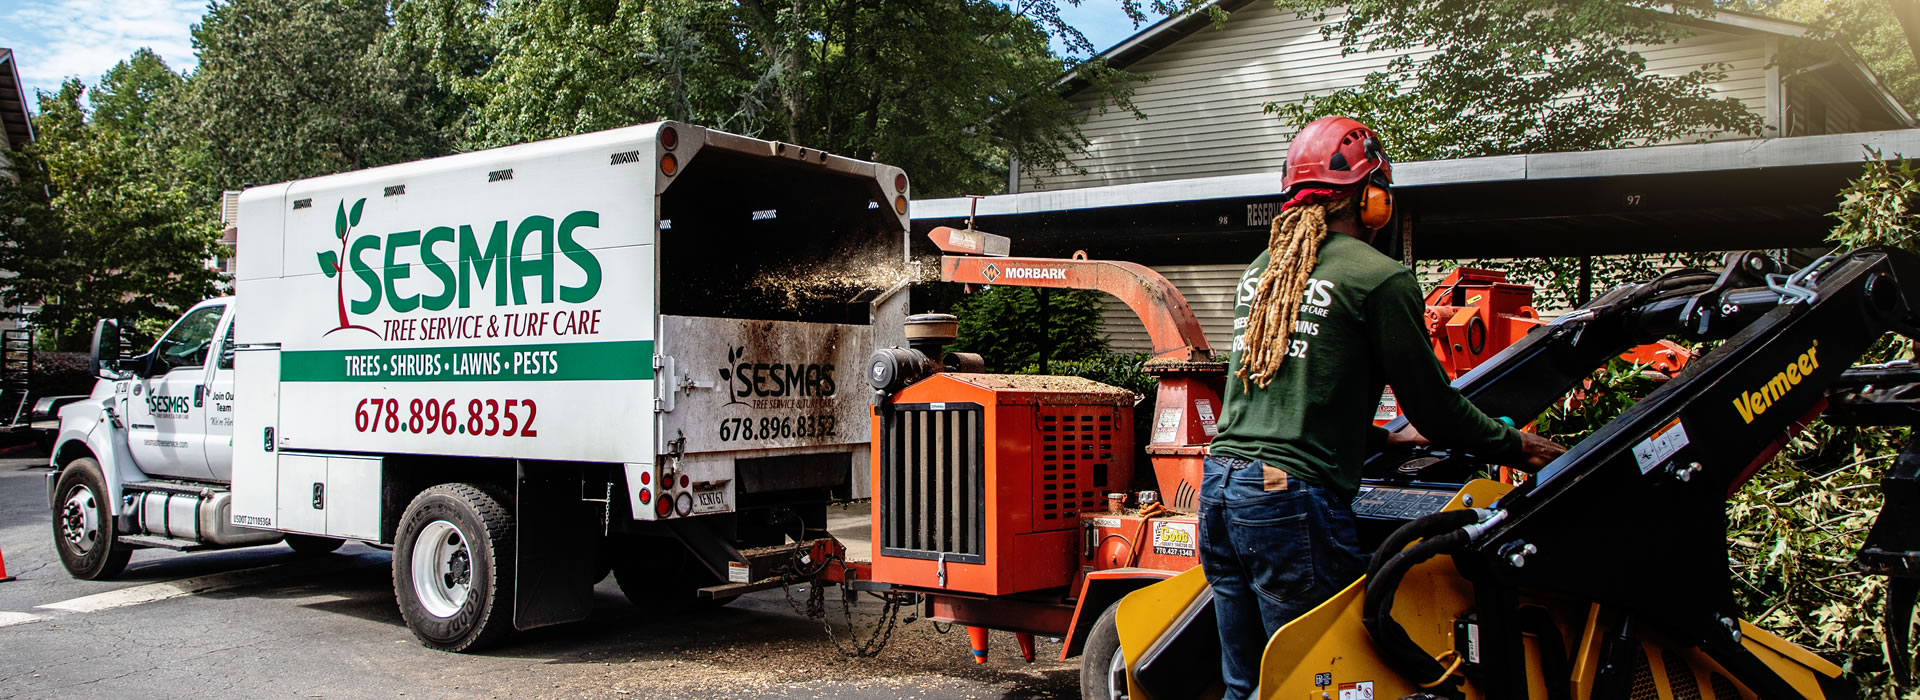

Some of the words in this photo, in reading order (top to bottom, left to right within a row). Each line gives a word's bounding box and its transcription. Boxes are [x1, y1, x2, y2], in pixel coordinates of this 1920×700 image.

[1627, 195, 1640, 205] 97
[1218, 216, 1228, 225] 98
[349, 210, 602, 315] SESMAS
[1005, 267, 1066, 279] MORBARK
[1308, 305, 1330, 317] CARE
[384, 319, 417, 341] TREE
[419, 315, 484, 341] SERVICE
[486, 314, 499, 338] &
[503, 312, 550, 337] TURF
[553, 309, 602, 336] CARE
[345, 355, 381, 377] TREES
[390, 354, 441, 377] SHRUBS
[452, 352, 501, 375] LAWNS
[513, 350, 558, 375] PESTS
[736, 363, 836, 397] SESMAS
[1732, 345, 1819, 424] Vermeer
[212, 391, 225, 401] Join
[225, 391, 234, 401] Ou
[151, 396, 190, 414] SESMAS
[216, 402, 232, 412] Team
[753, 399, 767, 409] TREE
[769, 399, 795, 409] SERVICE
[355, 397, 537, 437] 678.896.8352
[720, 415, 836, 441] 678.896.8352
[233, 514, 247, 524] USDOT
[1160, 526, 1189, 543] Cobb
[1156, 547, 1193, 557] 770.427.1348
